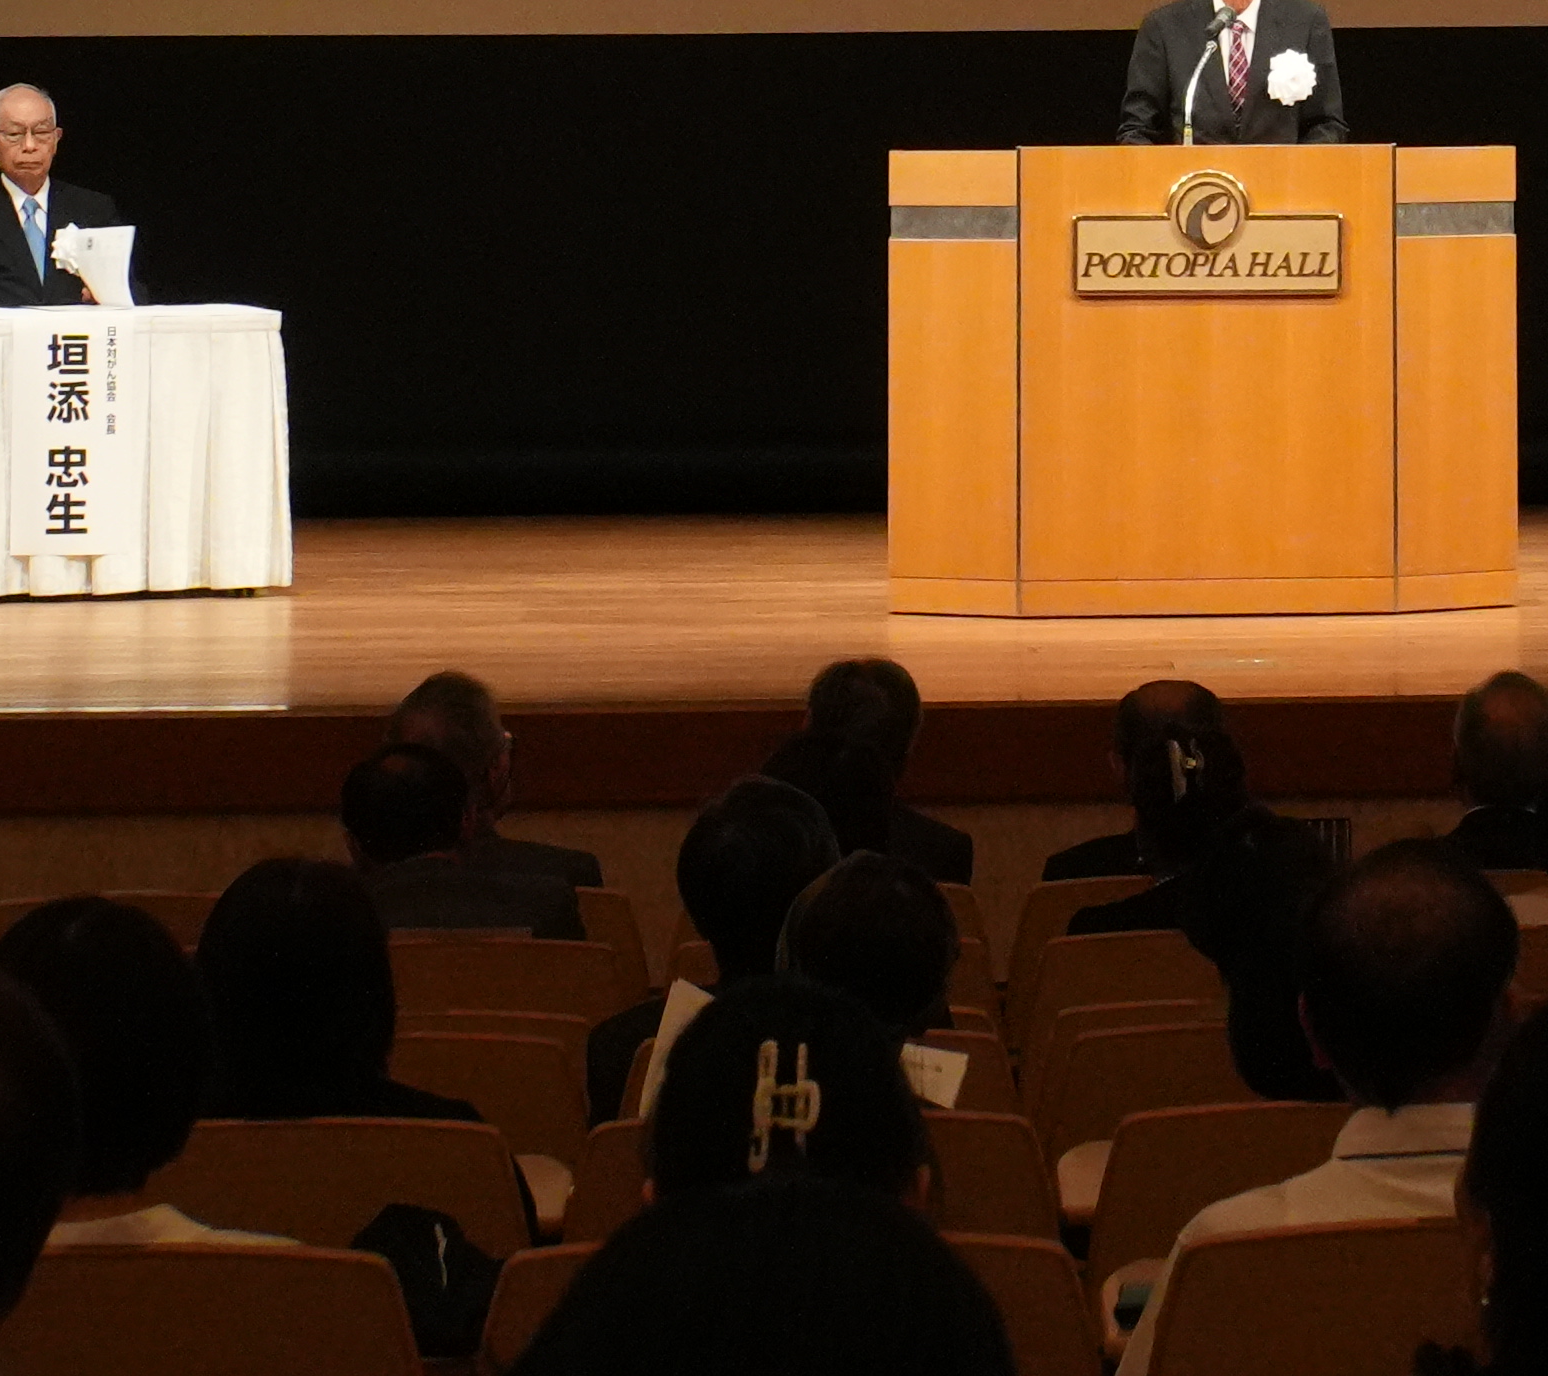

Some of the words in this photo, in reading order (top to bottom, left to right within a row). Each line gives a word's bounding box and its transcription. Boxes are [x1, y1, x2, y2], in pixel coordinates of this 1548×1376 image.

[1080, 251, 1239, 278] PORTOPIA
[1245, 251, 1336, 278] HALL
[46, 333, 90, 424] 垣添
[106, 326, 117, 402] 日本対がん協会
[106, 413, 116, 435] 会長
[45, 445, 89, 535] 忠生
